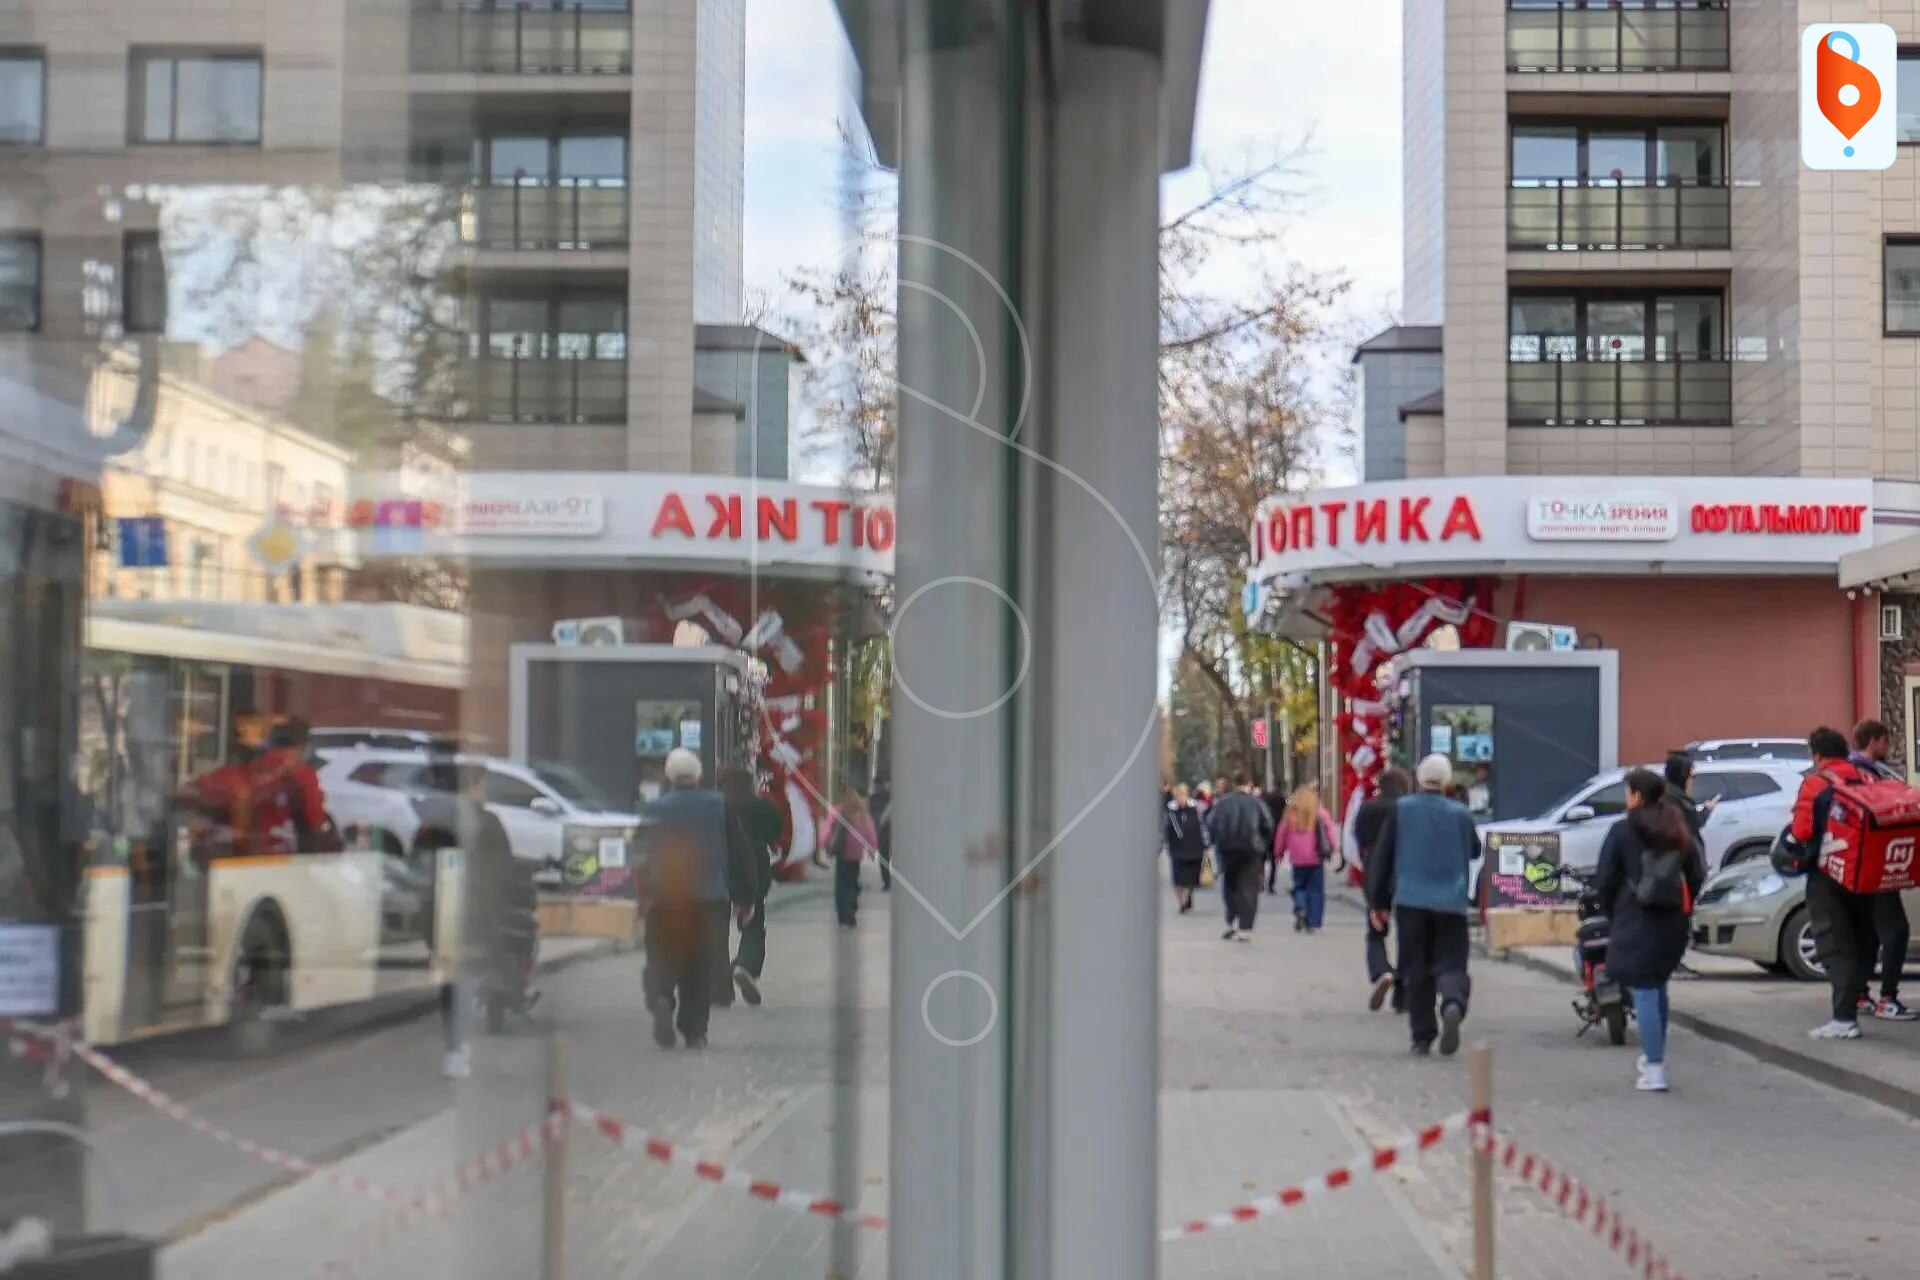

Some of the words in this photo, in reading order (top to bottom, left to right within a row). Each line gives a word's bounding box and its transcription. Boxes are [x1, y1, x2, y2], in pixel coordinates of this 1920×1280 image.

[1269, 496, 1481, 553] ОПТИКА
[1536, 499, 1607, 521] ТОЧКА
[1610, 506, 1669, 521] ЗРЕНИЯ
[1690, 504, 1868, 534] ОФТАЛЬМОЛОГ
